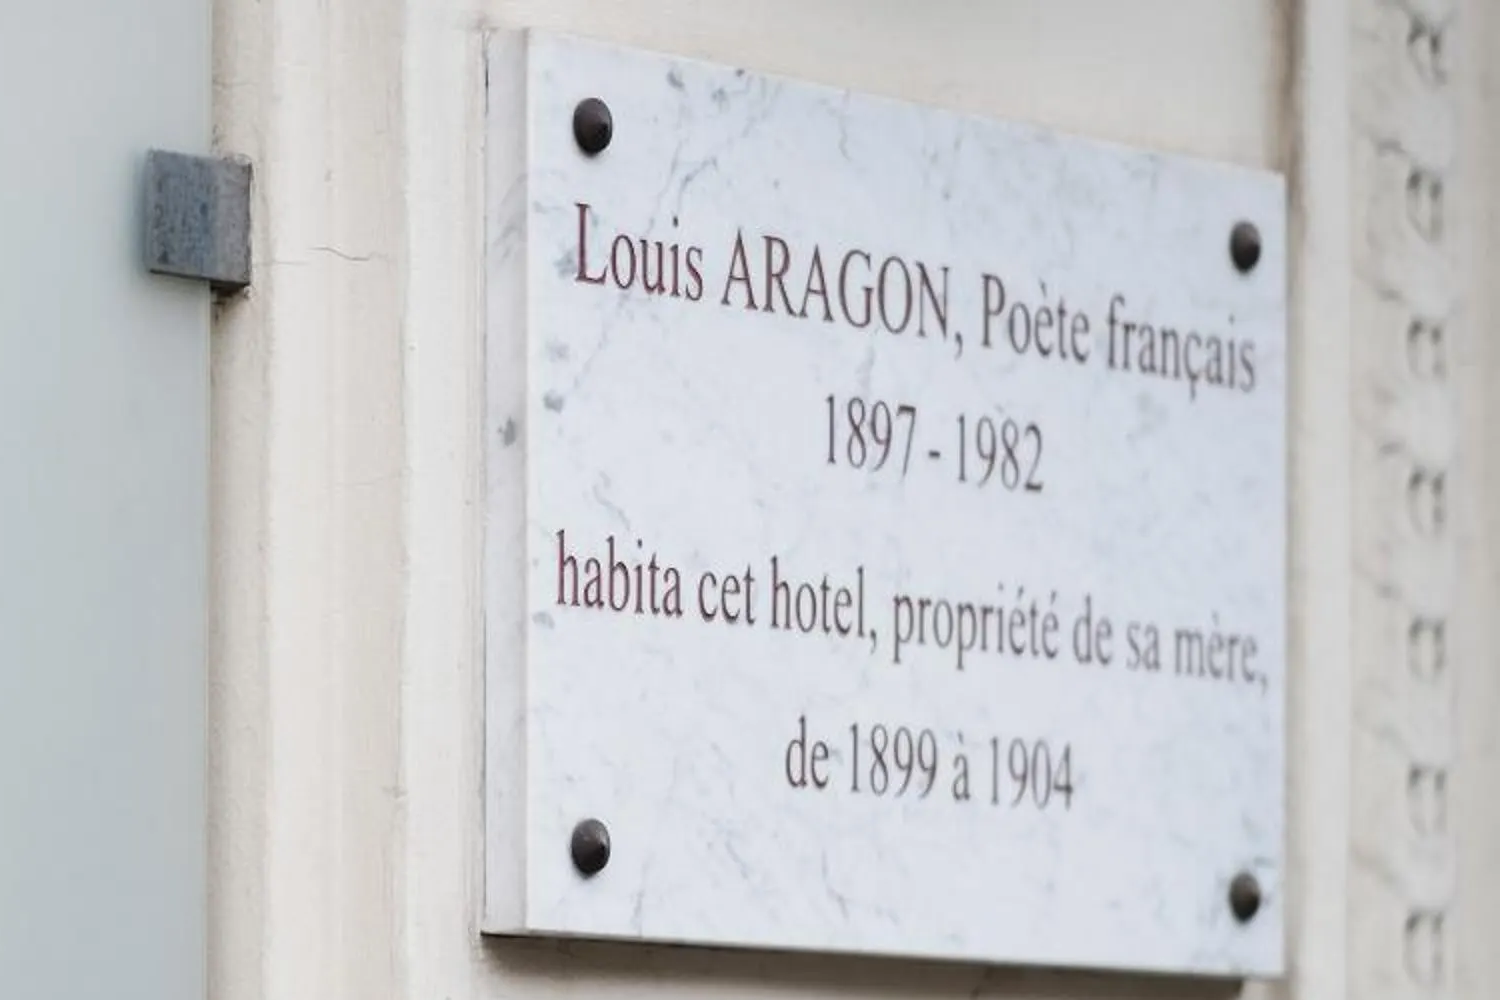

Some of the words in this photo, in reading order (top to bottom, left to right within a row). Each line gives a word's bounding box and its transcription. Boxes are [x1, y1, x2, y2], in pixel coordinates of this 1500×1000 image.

[574, 201, 703, 302] Louis
[719, 226, 964, 360] ARAGON,
[981, 271, 1091, 366] Poète
[1105, 292, 1257, 402] français
[555, 528, 684, 619] habita
[697, 564, 756, 626] cet
[770, 554, 878, 655] hotel,
[892, 581, 1060, 672] propriété
[1072, 592, 1113, 667] de
[1125, 618, 1161, 672] sa
[1173, 609, 1268, 696] mère,
[784, 714, 830, 790] de
[850, 721, 938, 801] 1899
[951, 729, 971, 803] à
[989, 735, 1074, 812] 1904
